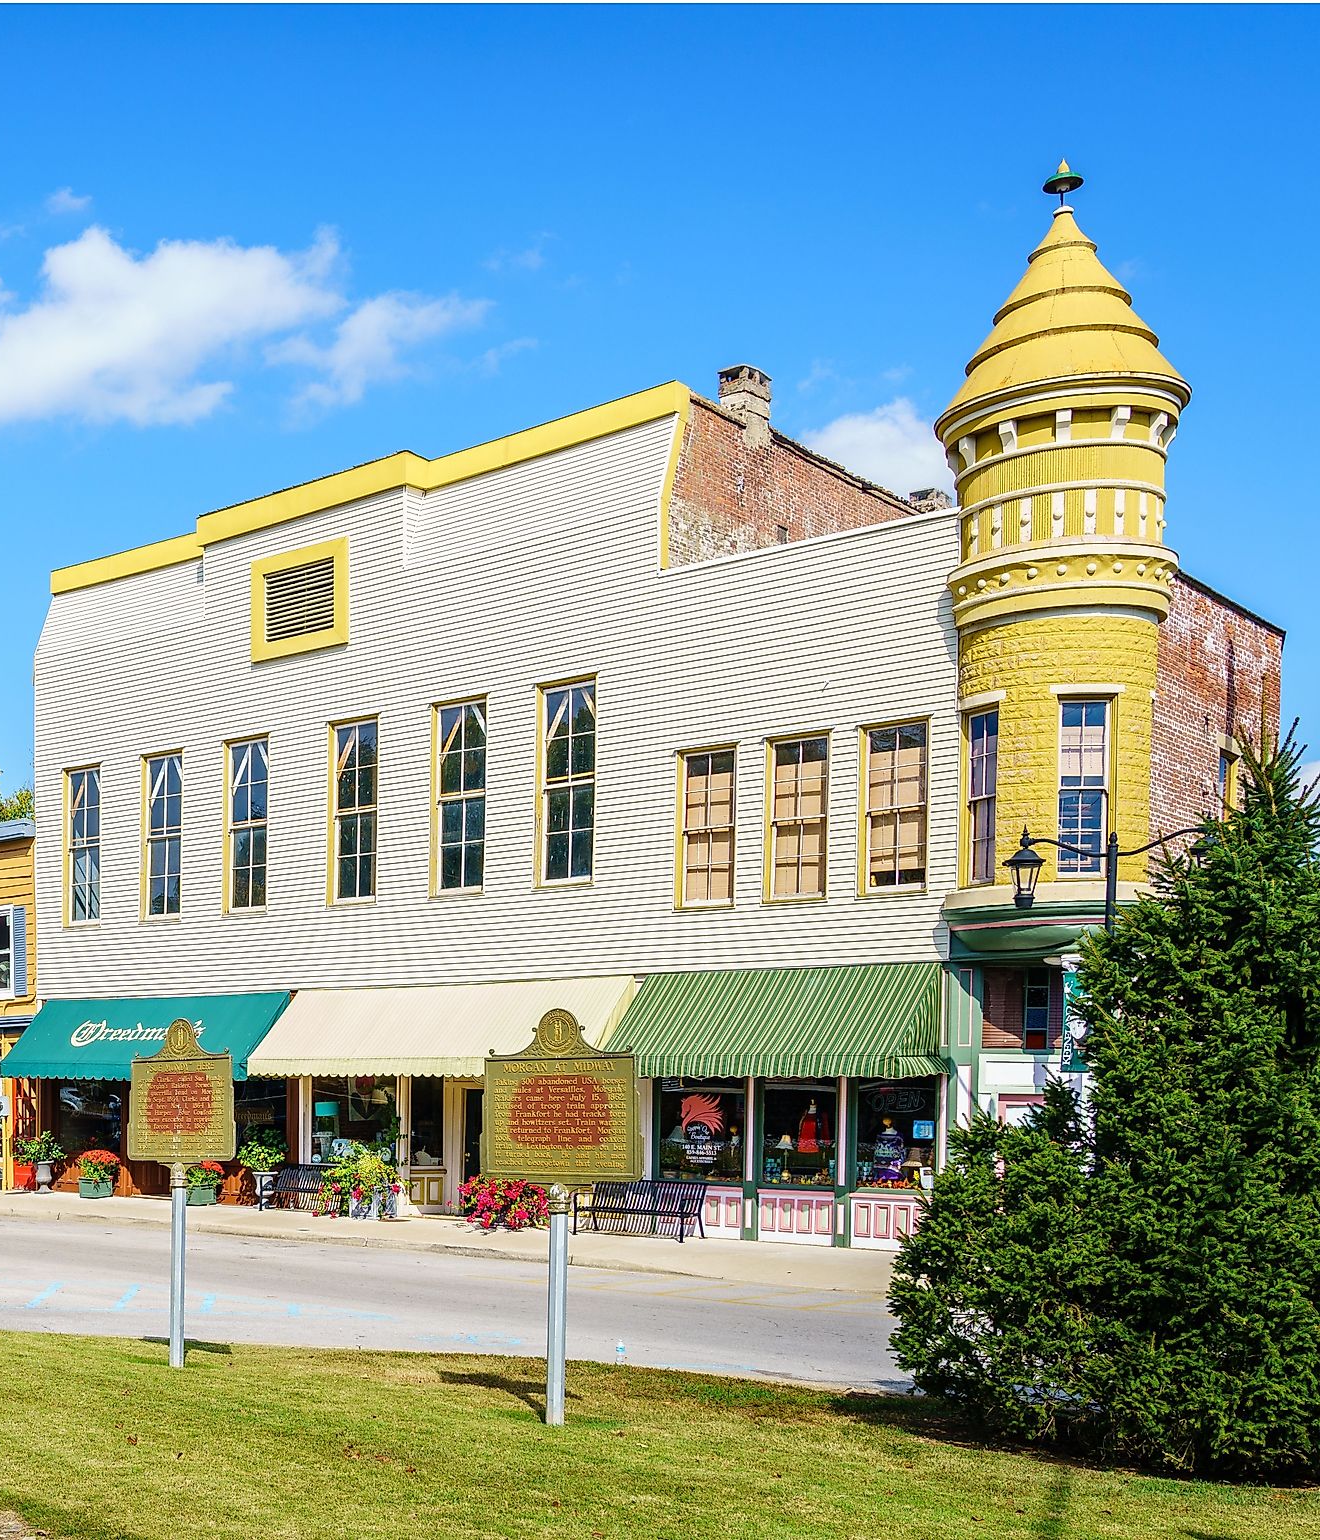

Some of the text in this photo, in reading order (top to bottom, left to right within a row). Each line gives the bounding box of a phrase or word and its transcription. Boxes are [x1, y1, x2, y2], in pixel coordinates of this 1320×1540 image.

[503, 1060, 616, 1073] MORGAN AT MIDWAY
[538, 1076, 578, 1086] abandoned
[581, 1076, 598, 1085] USA
[512, 1086, 532, 1094] mules
[535, 1086, 544, 1094] at
[548, 1094, 566, 1102] here
[570, 1093, 586, 1102] July
[872, 1091, 921, 1112] OPEN
[527, 1102, 536, 1110] of
[541, 1102, 561, 1111] troop
[566, 1101, 586, 1110] train
[590, 1101, 627, 1111] approach
[515, 1110, 551, 1118] Frankfort
[553, 1110, 562, 1118] he
[565, 1110, 579, 1118] had
[582, 1109, 606, 1118] tracks
[521, 1118, 556, 1126] howitzers
[575, 1118, 596, 1126] Train
[510, 1126, 542, 1134] returned
[544, 1126, 552, 1134] to
[597, 1126, 627, 1136] Morgan
[517, 1134, 551, 1144] telegraph
[557, 1134, 572, 1142] line
[578, 1134, 593, 1142] and
[690, 1132, 710, 1142] Boutique
[526, 1142, 563, 1152] Lexington
[565, 1142, 574, 1151] to
